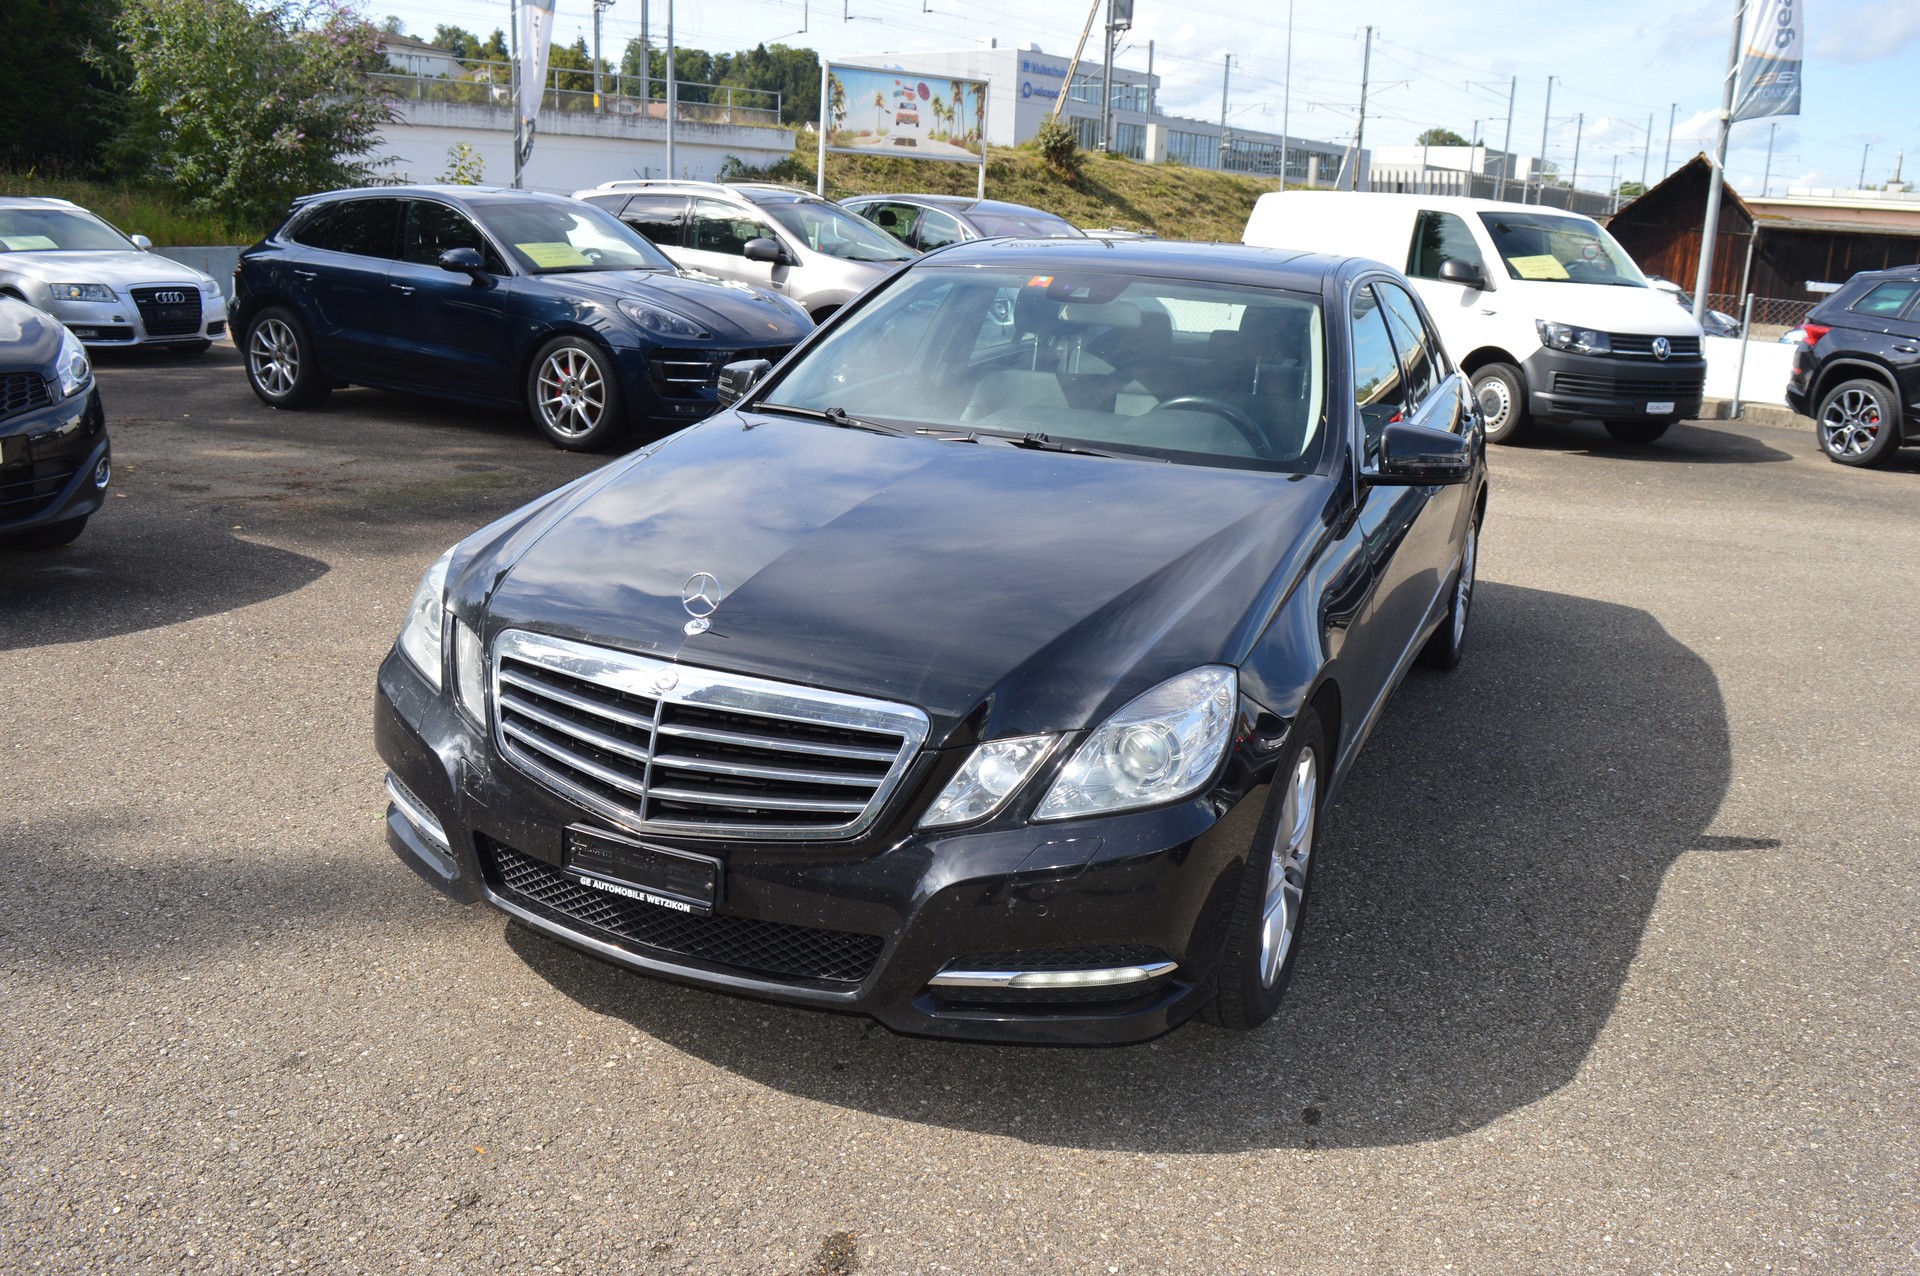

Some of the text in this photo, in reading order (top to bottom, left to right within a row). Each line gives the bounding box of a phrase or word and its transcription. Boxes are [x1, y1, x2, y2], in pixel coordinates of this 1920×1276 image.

[580, 877, 691, 913] GE AUTOMOBILE WETZIKON
